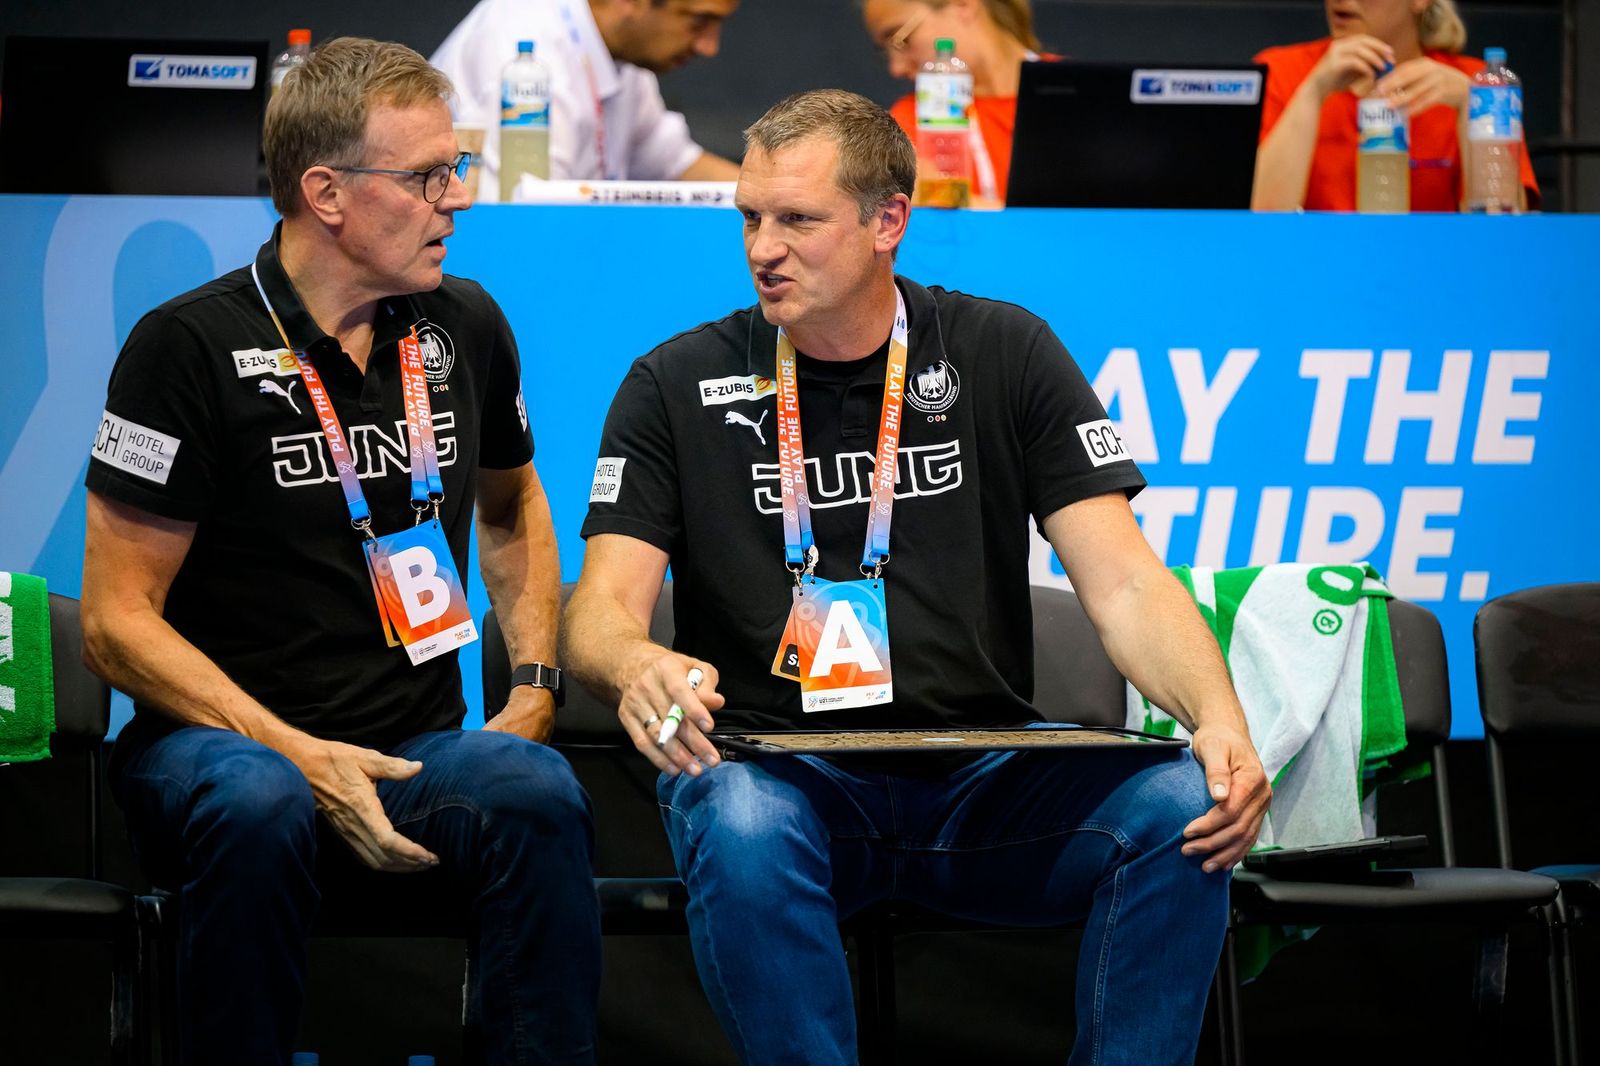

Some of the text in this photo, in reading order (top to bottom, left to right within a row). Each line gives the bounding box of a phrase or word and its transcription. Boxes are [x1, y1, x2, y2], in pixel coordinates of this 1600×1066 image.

[167, 64, 250, 78] TOMASOFT
[406, 343, 431, 430] THE FUTURE.
[704, 382, 754, 398] E-ZUBIS
[781, 356, 797, 411] FUTURE.
[311, 387, 330, 413] THE
[1092, 348, 1550, 464] AY THE
[321, 417, 344, 453] PLAY
[786, 417, 800, 444] THE
[880, 362, 903, 492] PLAY THE FUTURE.
[128, 430, 165, 456] HOTEL
[122, 449, 165, 474] GROUP
[595, 464, 617, 477] HOTEL
[790, 449, 804, 484] PLAY
[592, 483, 617, 496] GROUP
[388, 545, 452, 629] B
[808, 599, 884, 678] A
